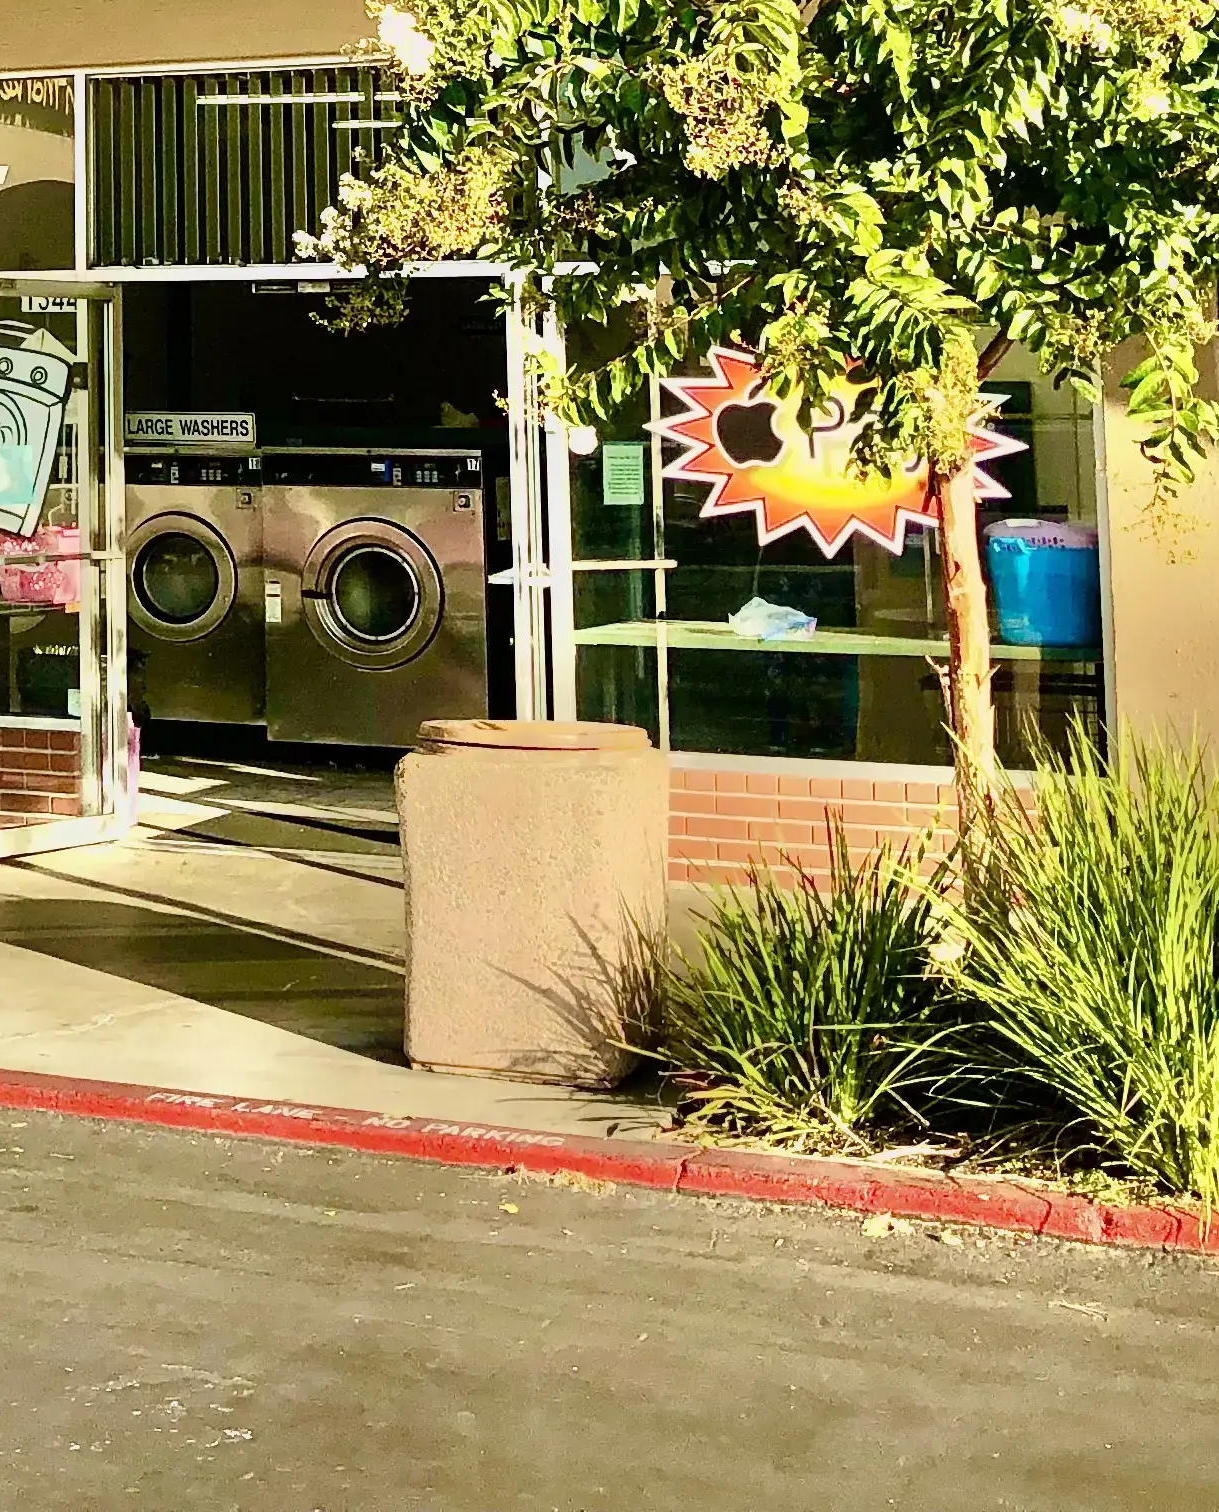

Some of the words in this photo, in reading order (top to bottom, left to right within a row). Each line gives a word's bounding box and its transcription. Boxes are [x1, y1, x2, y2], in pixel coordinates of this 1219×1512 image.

[126, 418, 174, 436] LARGE
[178, 419, 250, 437] WASHERS
[145, 1092, 224, 1109] FIRE
[231, 1101, 324, 1120] LANE
[362, 1116, 412, 1129] NO
[421, 1122, 566, 1146] PARKING
